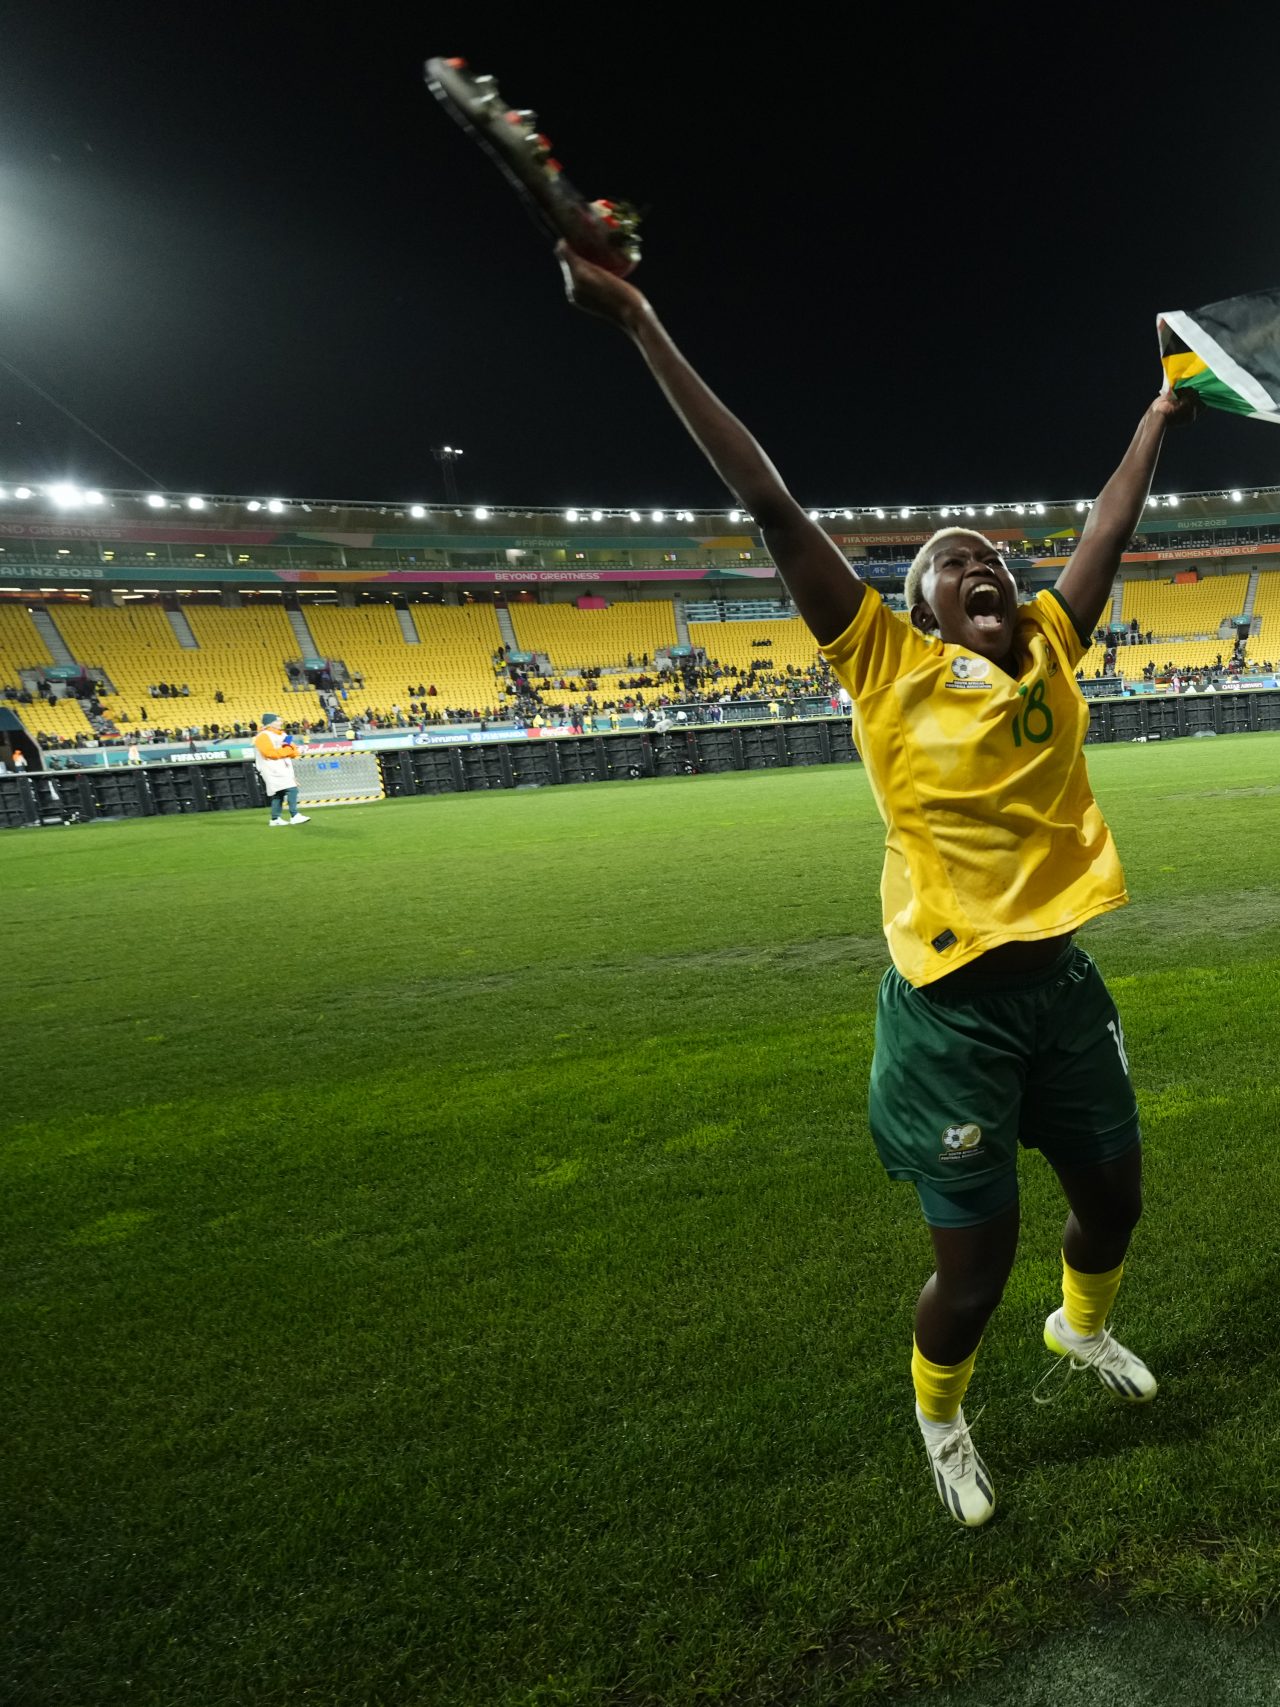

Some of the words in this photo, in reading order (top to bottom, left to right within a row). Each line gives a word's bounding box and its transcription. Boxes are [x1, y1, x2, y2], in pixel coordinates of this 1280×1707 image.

[1174, 549, 1211, 558] WOMEN'S
[1213, 547, 1240, 556] WORLD
[540, 572, 601, 580] GREATNESS
[431, 735, 469, 744] HYUNDAI
[170, 754, 195, 763] FIFA
[195, 751, 227, 761] STORE
